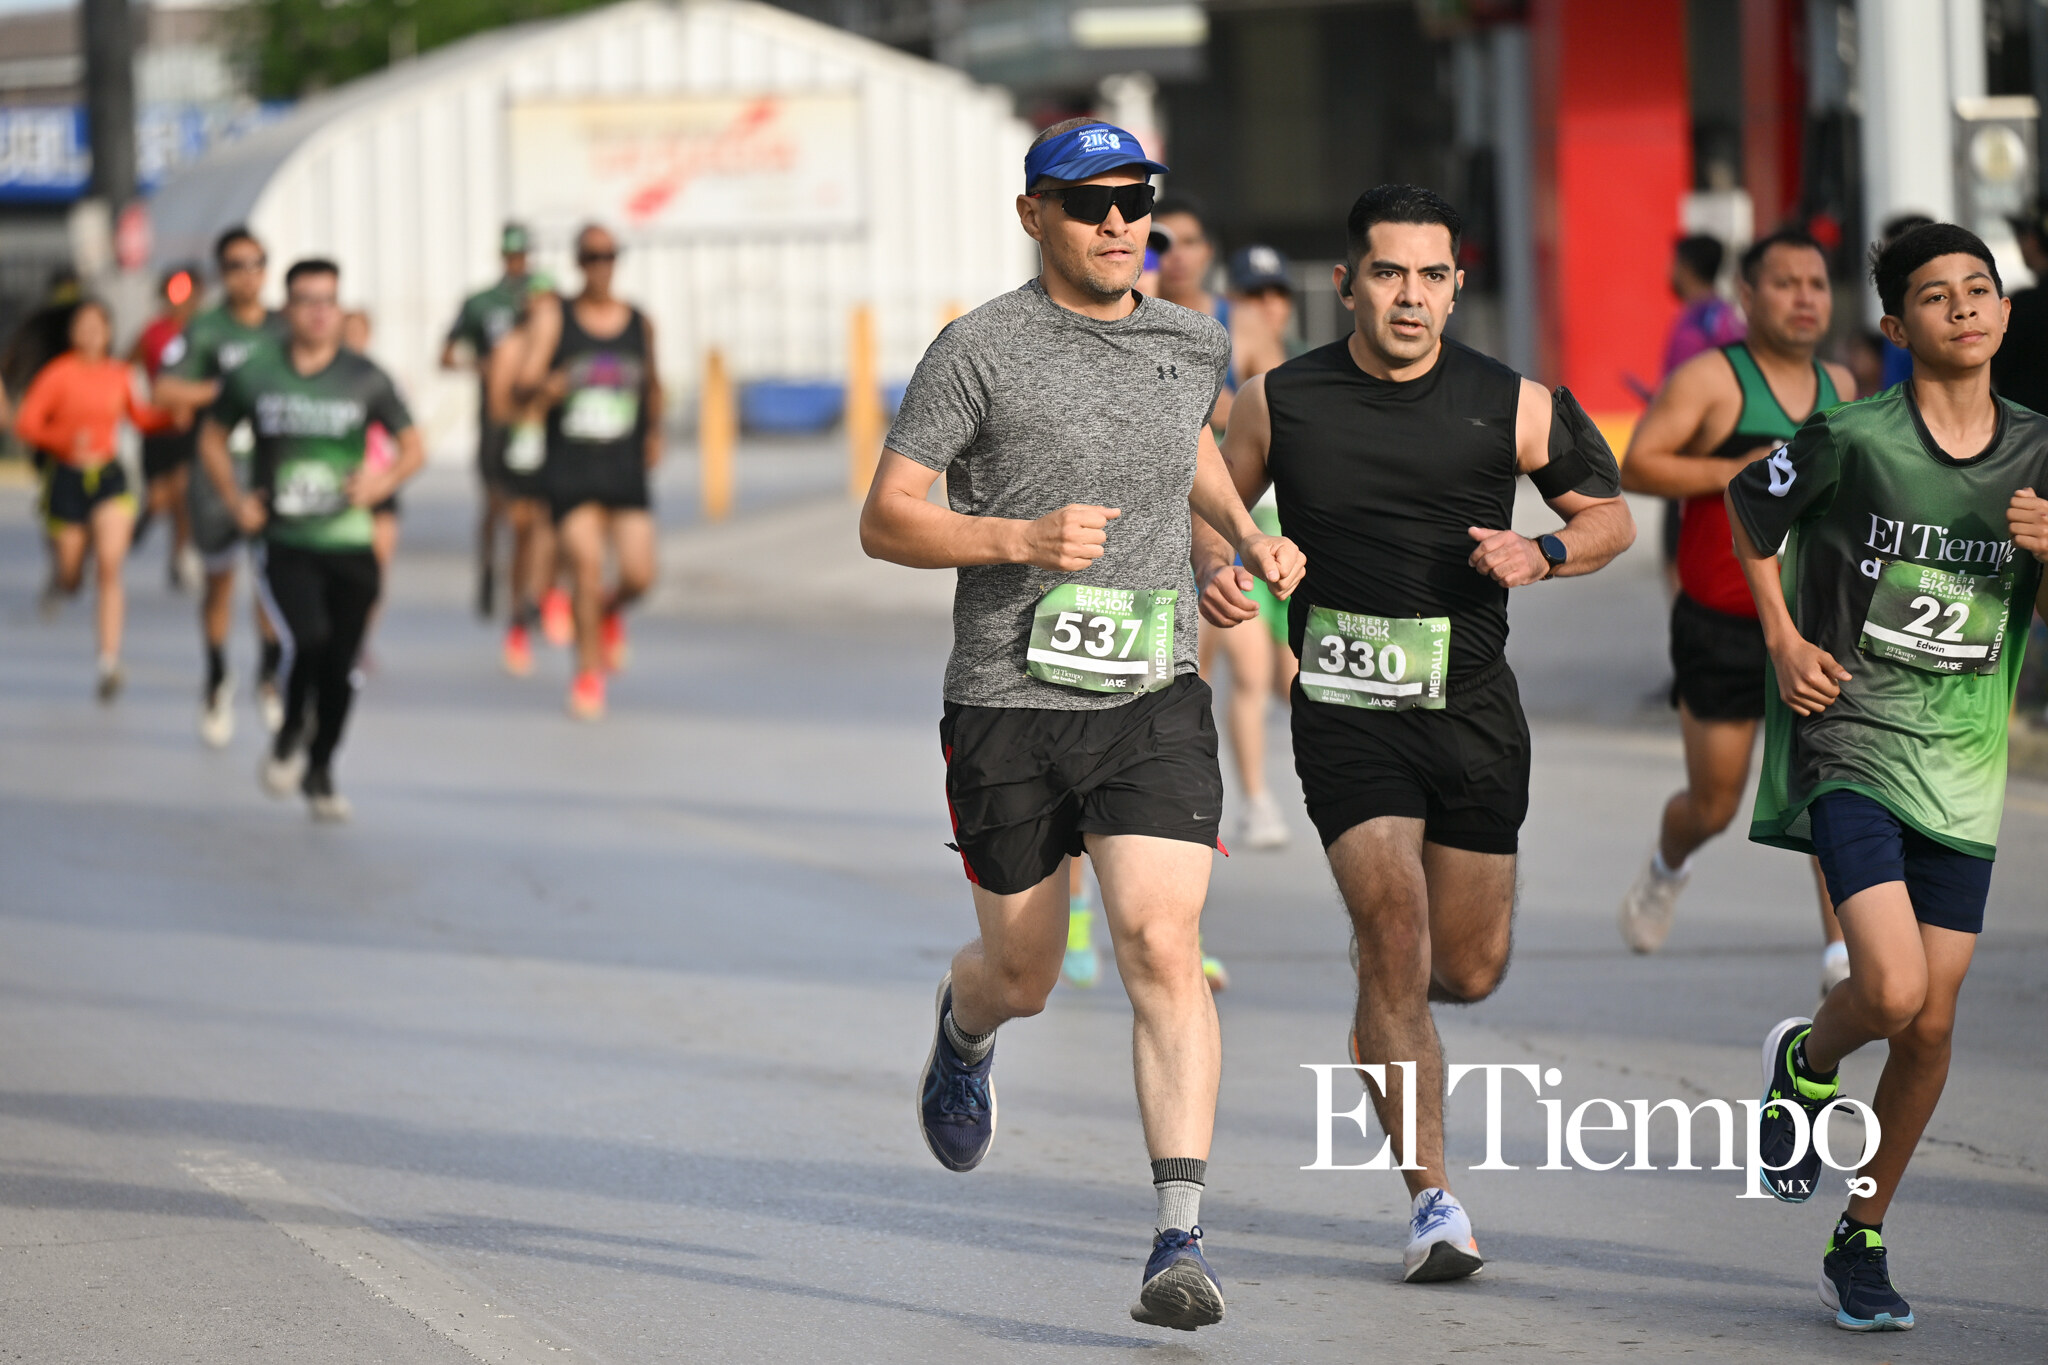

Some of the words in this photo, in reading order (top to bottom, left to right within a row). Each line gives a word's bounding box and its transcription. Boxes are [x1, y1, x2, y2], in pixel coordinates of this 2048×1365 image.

[1864, 512, 1904, 556] El
[1076, 586, 1134, 600] CARRERA
[1922, 570, 1975, 585] CARRERA
[1155, 597, 1173, 605] 537
[1337, 613, 1390, 627] CARRERA
[1902, 596, 1969, 642] 22
[1050, 612, 1143, 659] 537
[1156, 612, 1167, 680] MEDALLA
[1430, 624, 1447, 633] 330
[1916, 640, 1945, 653] Edwin
[1988, 597, 2010, 662] MEDALLA
[1318, 635, 1406, 682] 330
[1428, 638, 1444, 698] MEDALLA
